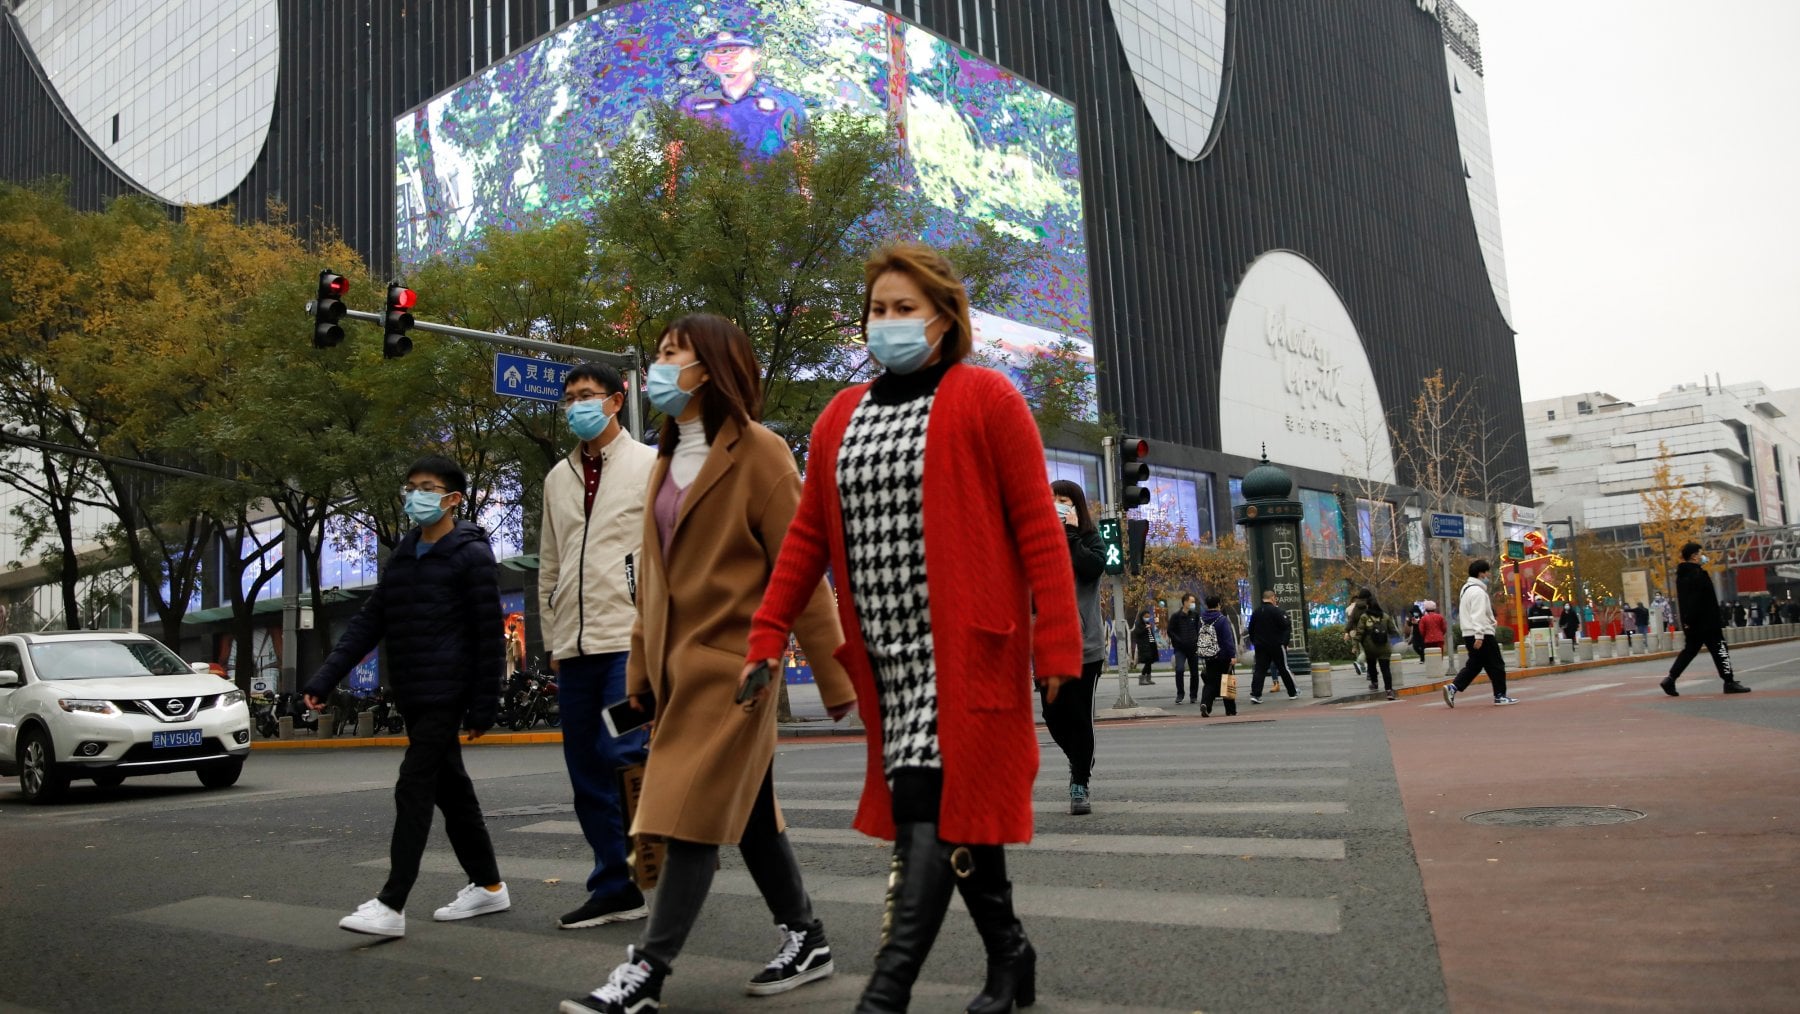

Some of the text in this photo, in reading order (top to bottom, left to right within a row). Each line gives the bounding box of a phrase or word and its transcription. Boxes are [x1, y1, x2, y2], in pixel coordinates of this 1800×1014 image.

[524, 383, 559, 396] LINGJING
[1103, 523, 1118, 539] 27
[1272, 541, 1296, 577] P
